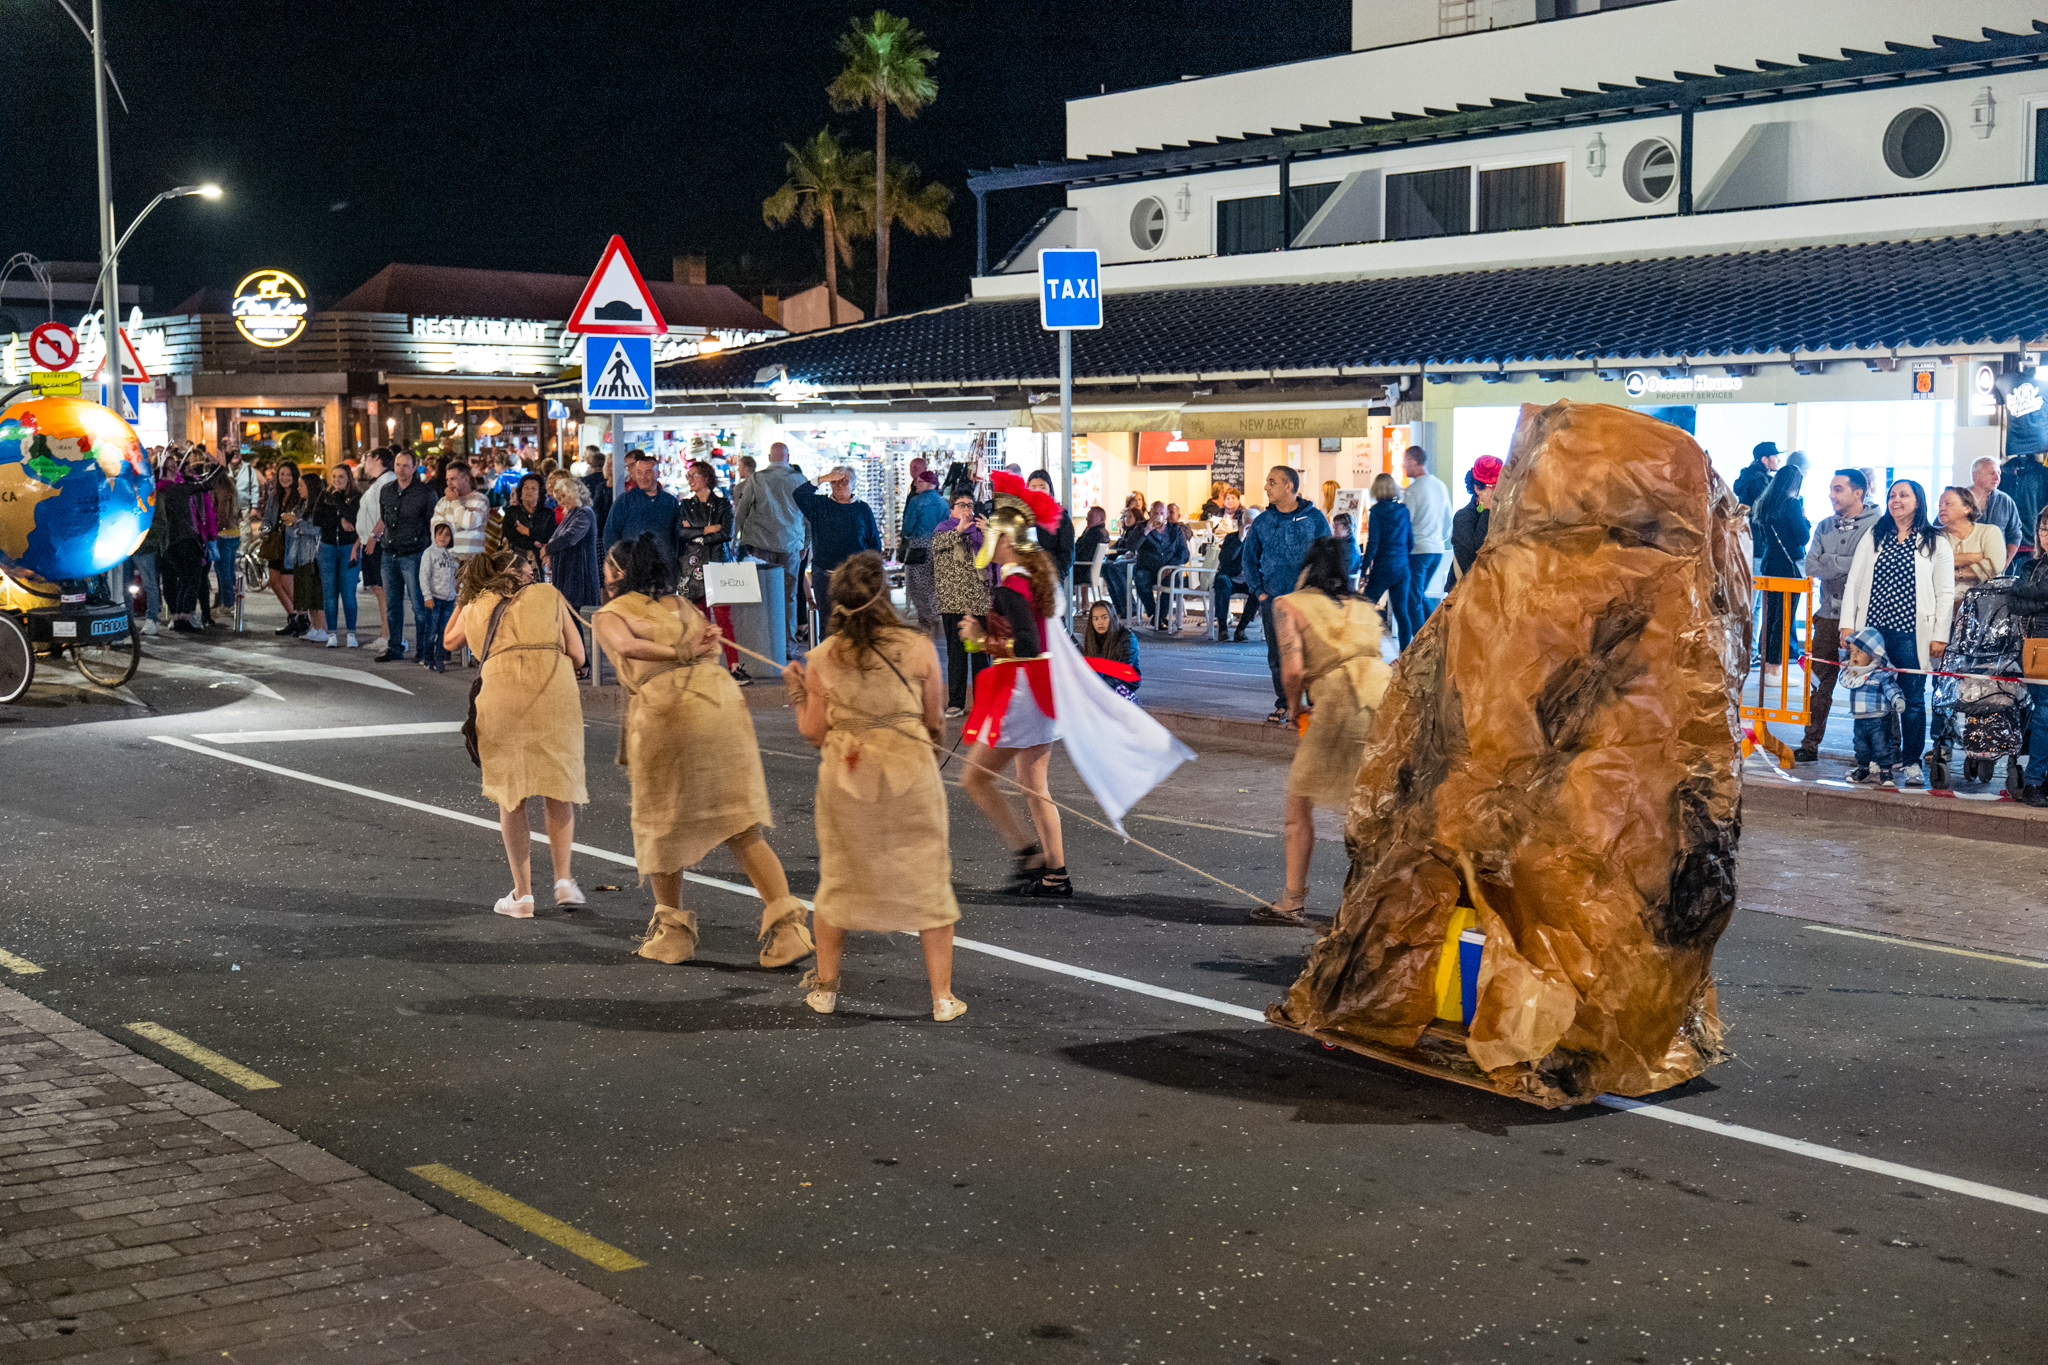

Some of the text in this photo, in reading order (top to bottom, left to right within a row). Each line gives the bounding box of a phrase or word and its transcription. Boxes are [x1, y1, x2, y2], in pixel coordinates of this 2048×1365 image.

[1047, 278, 1096, 299] TAXI
[413, 317, 547, 342] RESTAURANT
[1646, 375, 1743, 392] Ocean House
[1697, 391, 1733, 399] SERVICES
[1239, 419, 1264, 431] NEW
[1267, 418, 1307, 431] BAKERY
[1388, 440, 1406, 454] NEW
